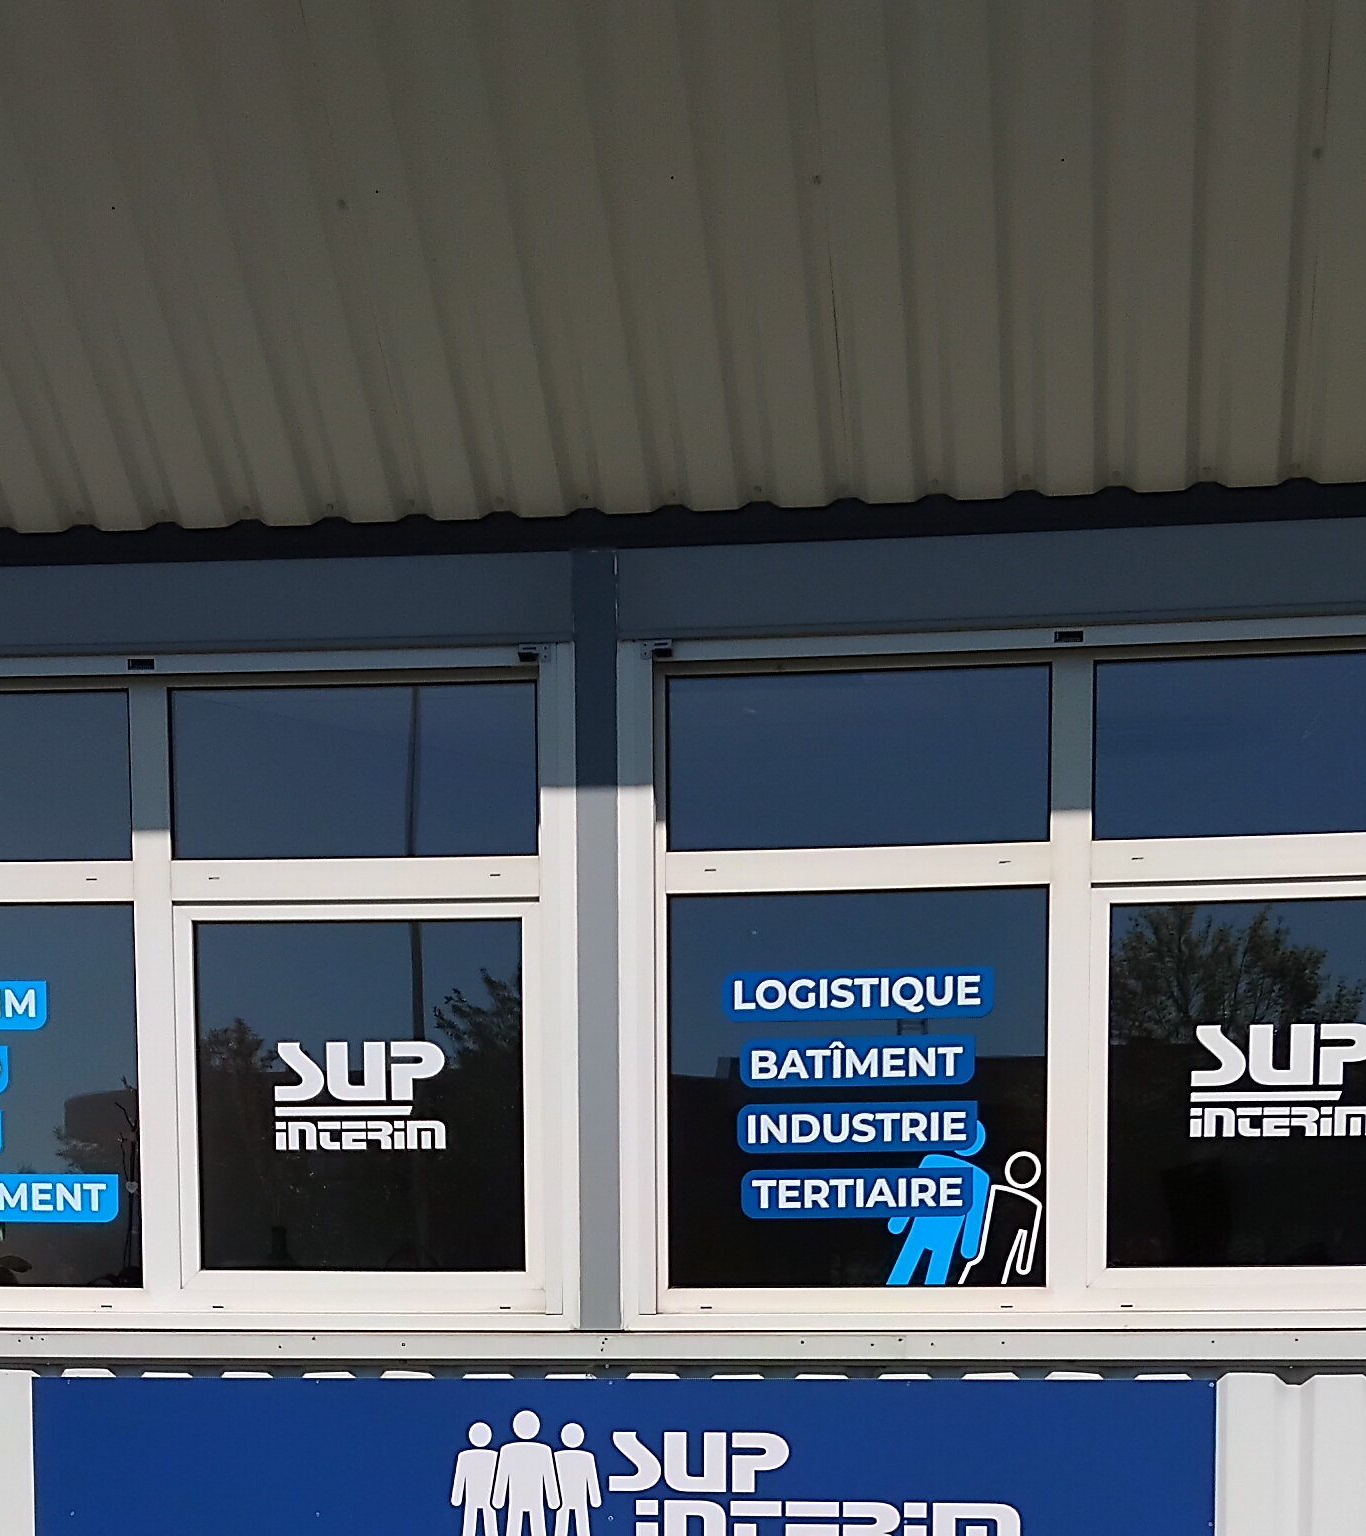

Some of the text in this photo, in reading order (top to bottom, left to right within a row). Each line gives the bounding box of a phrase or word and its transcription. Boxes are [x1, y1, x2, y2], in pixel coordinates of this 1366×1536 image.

[734, 975, 981, 1013] LOGISTIQUE
[274, 1040, 446, 1102] SUP
[751, 1041, 964, 1080] BATÎMENT
[747, 1111, 967, 1144] INDUSTRIE
[751, 1177, 963, 1209] TERTIAIRE
[608, 1431, 790, 1493] SUP
